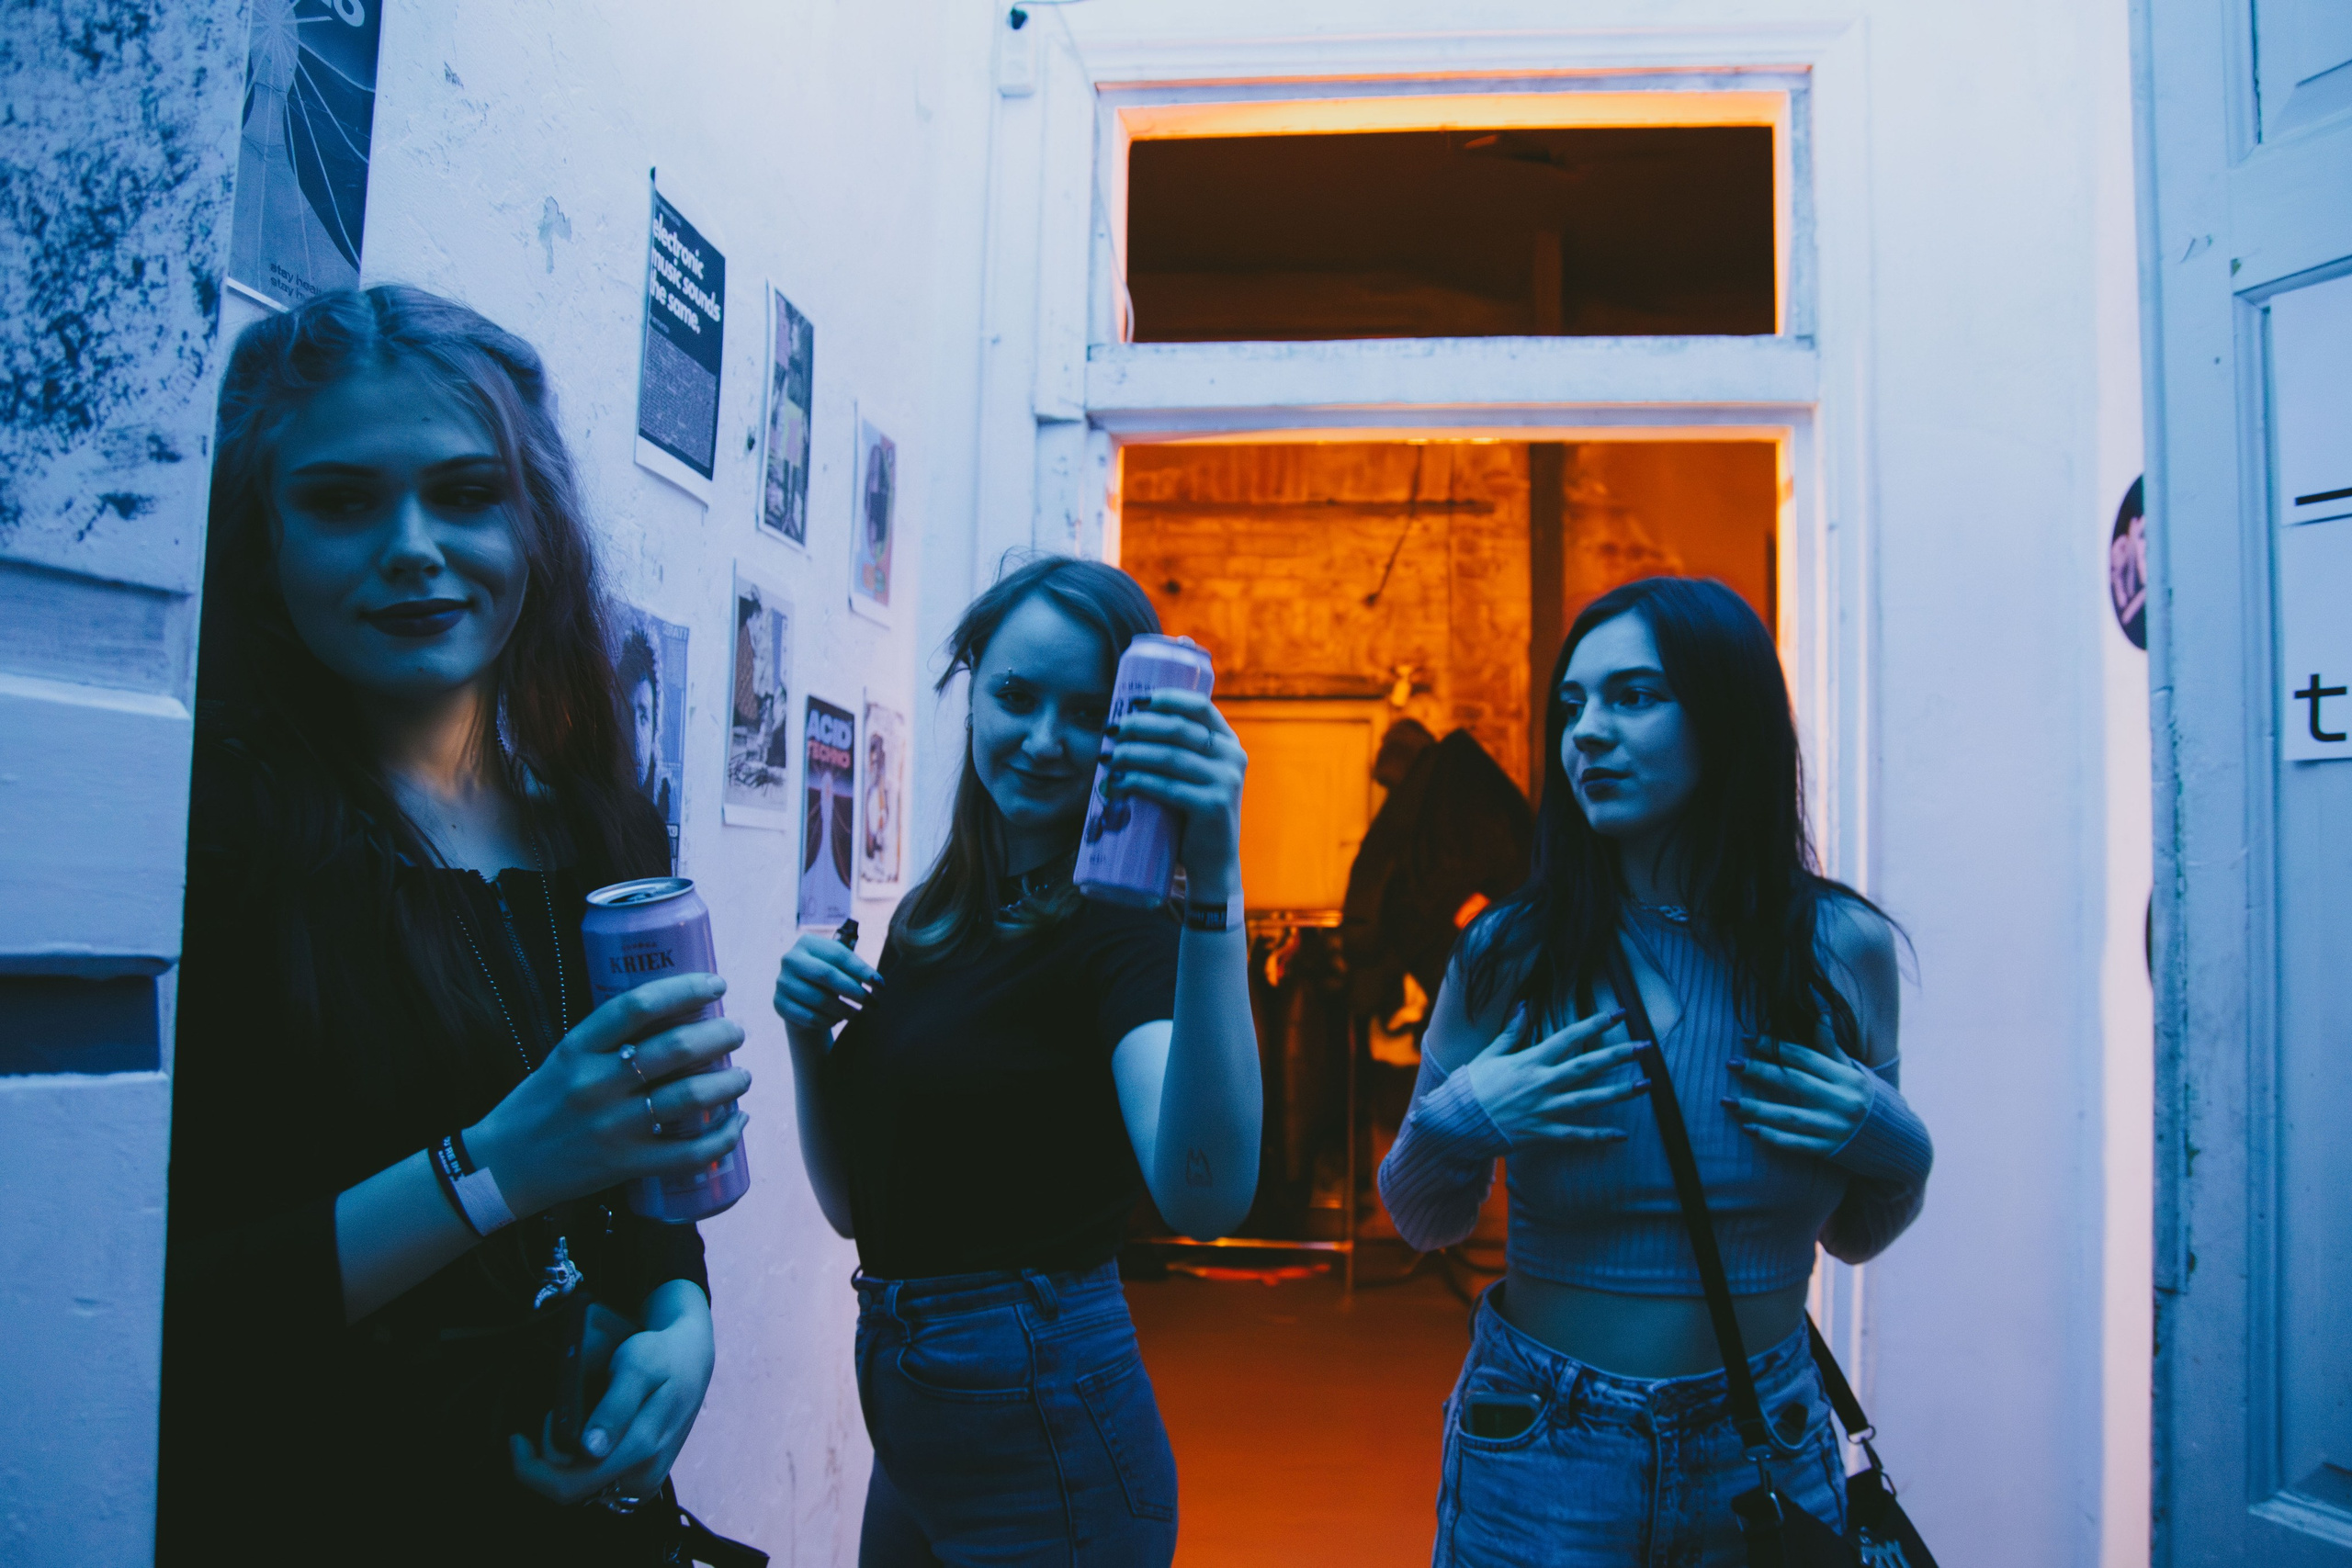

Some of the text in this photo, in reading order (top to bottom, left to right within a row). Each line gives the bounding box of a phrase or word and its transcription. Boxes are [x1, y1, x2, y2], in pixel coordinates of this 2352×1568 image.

[652, 212, 705, 280] electronic
[269, 263, 294, 283] stay
[270, 276, 294, 297] stay
[651, 246, 721, 322] music sounds
[650, 268, 667, 306] the
[667, 292, 701, 335] same.
[807, 708, 853, 751] ACID
[608, 948, 676, 975] KRIEK
